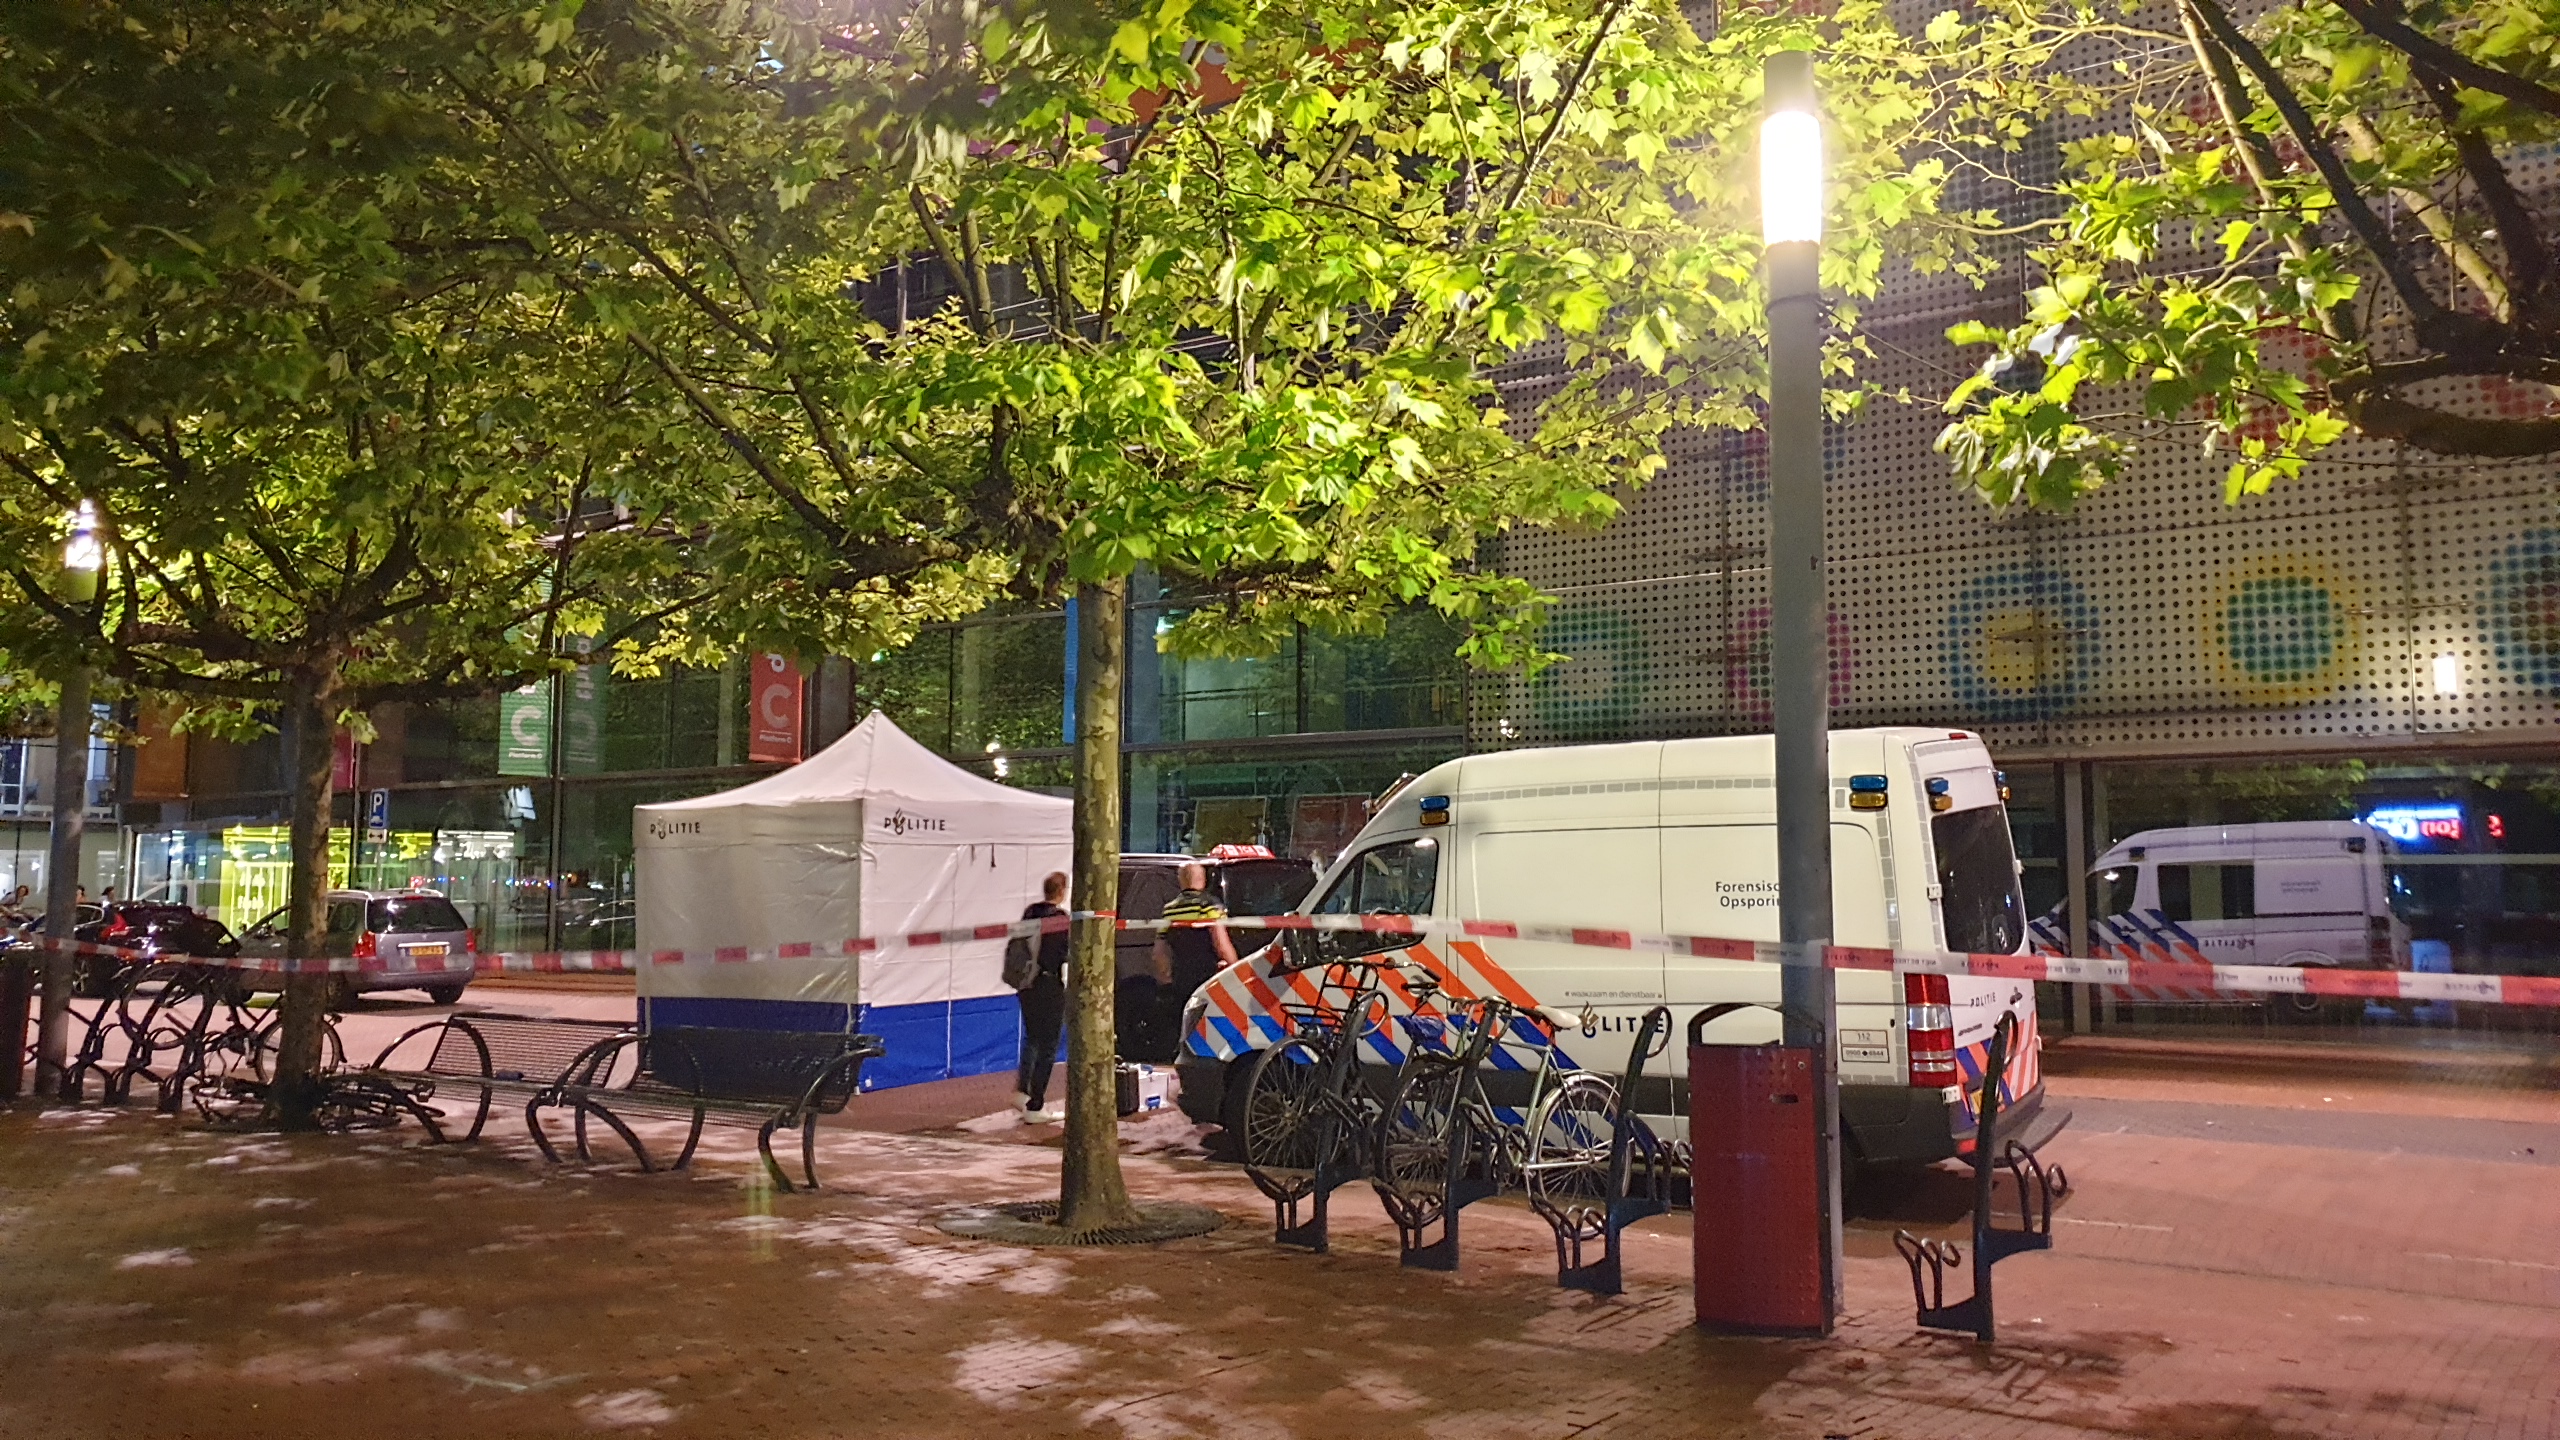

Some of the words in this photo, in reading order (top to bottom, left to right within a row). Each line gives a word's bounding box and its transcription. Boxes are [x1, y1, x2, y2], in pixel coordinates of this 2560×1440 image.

[761, 683, 792, 729] C
[511, 705, 542, 746] C
[373, 792, 383, 813] P
[650, 816, 700, 839] POLITIE
[883, 808, 946, 835] POLITIE
[1715, 880, 1780, 892] Forensisc
[1720, 894, 1780, 909] Opspori
[1970, 992, 1996, 1008] POLITIE
[1857, 1032, 1871, 1041] 112
